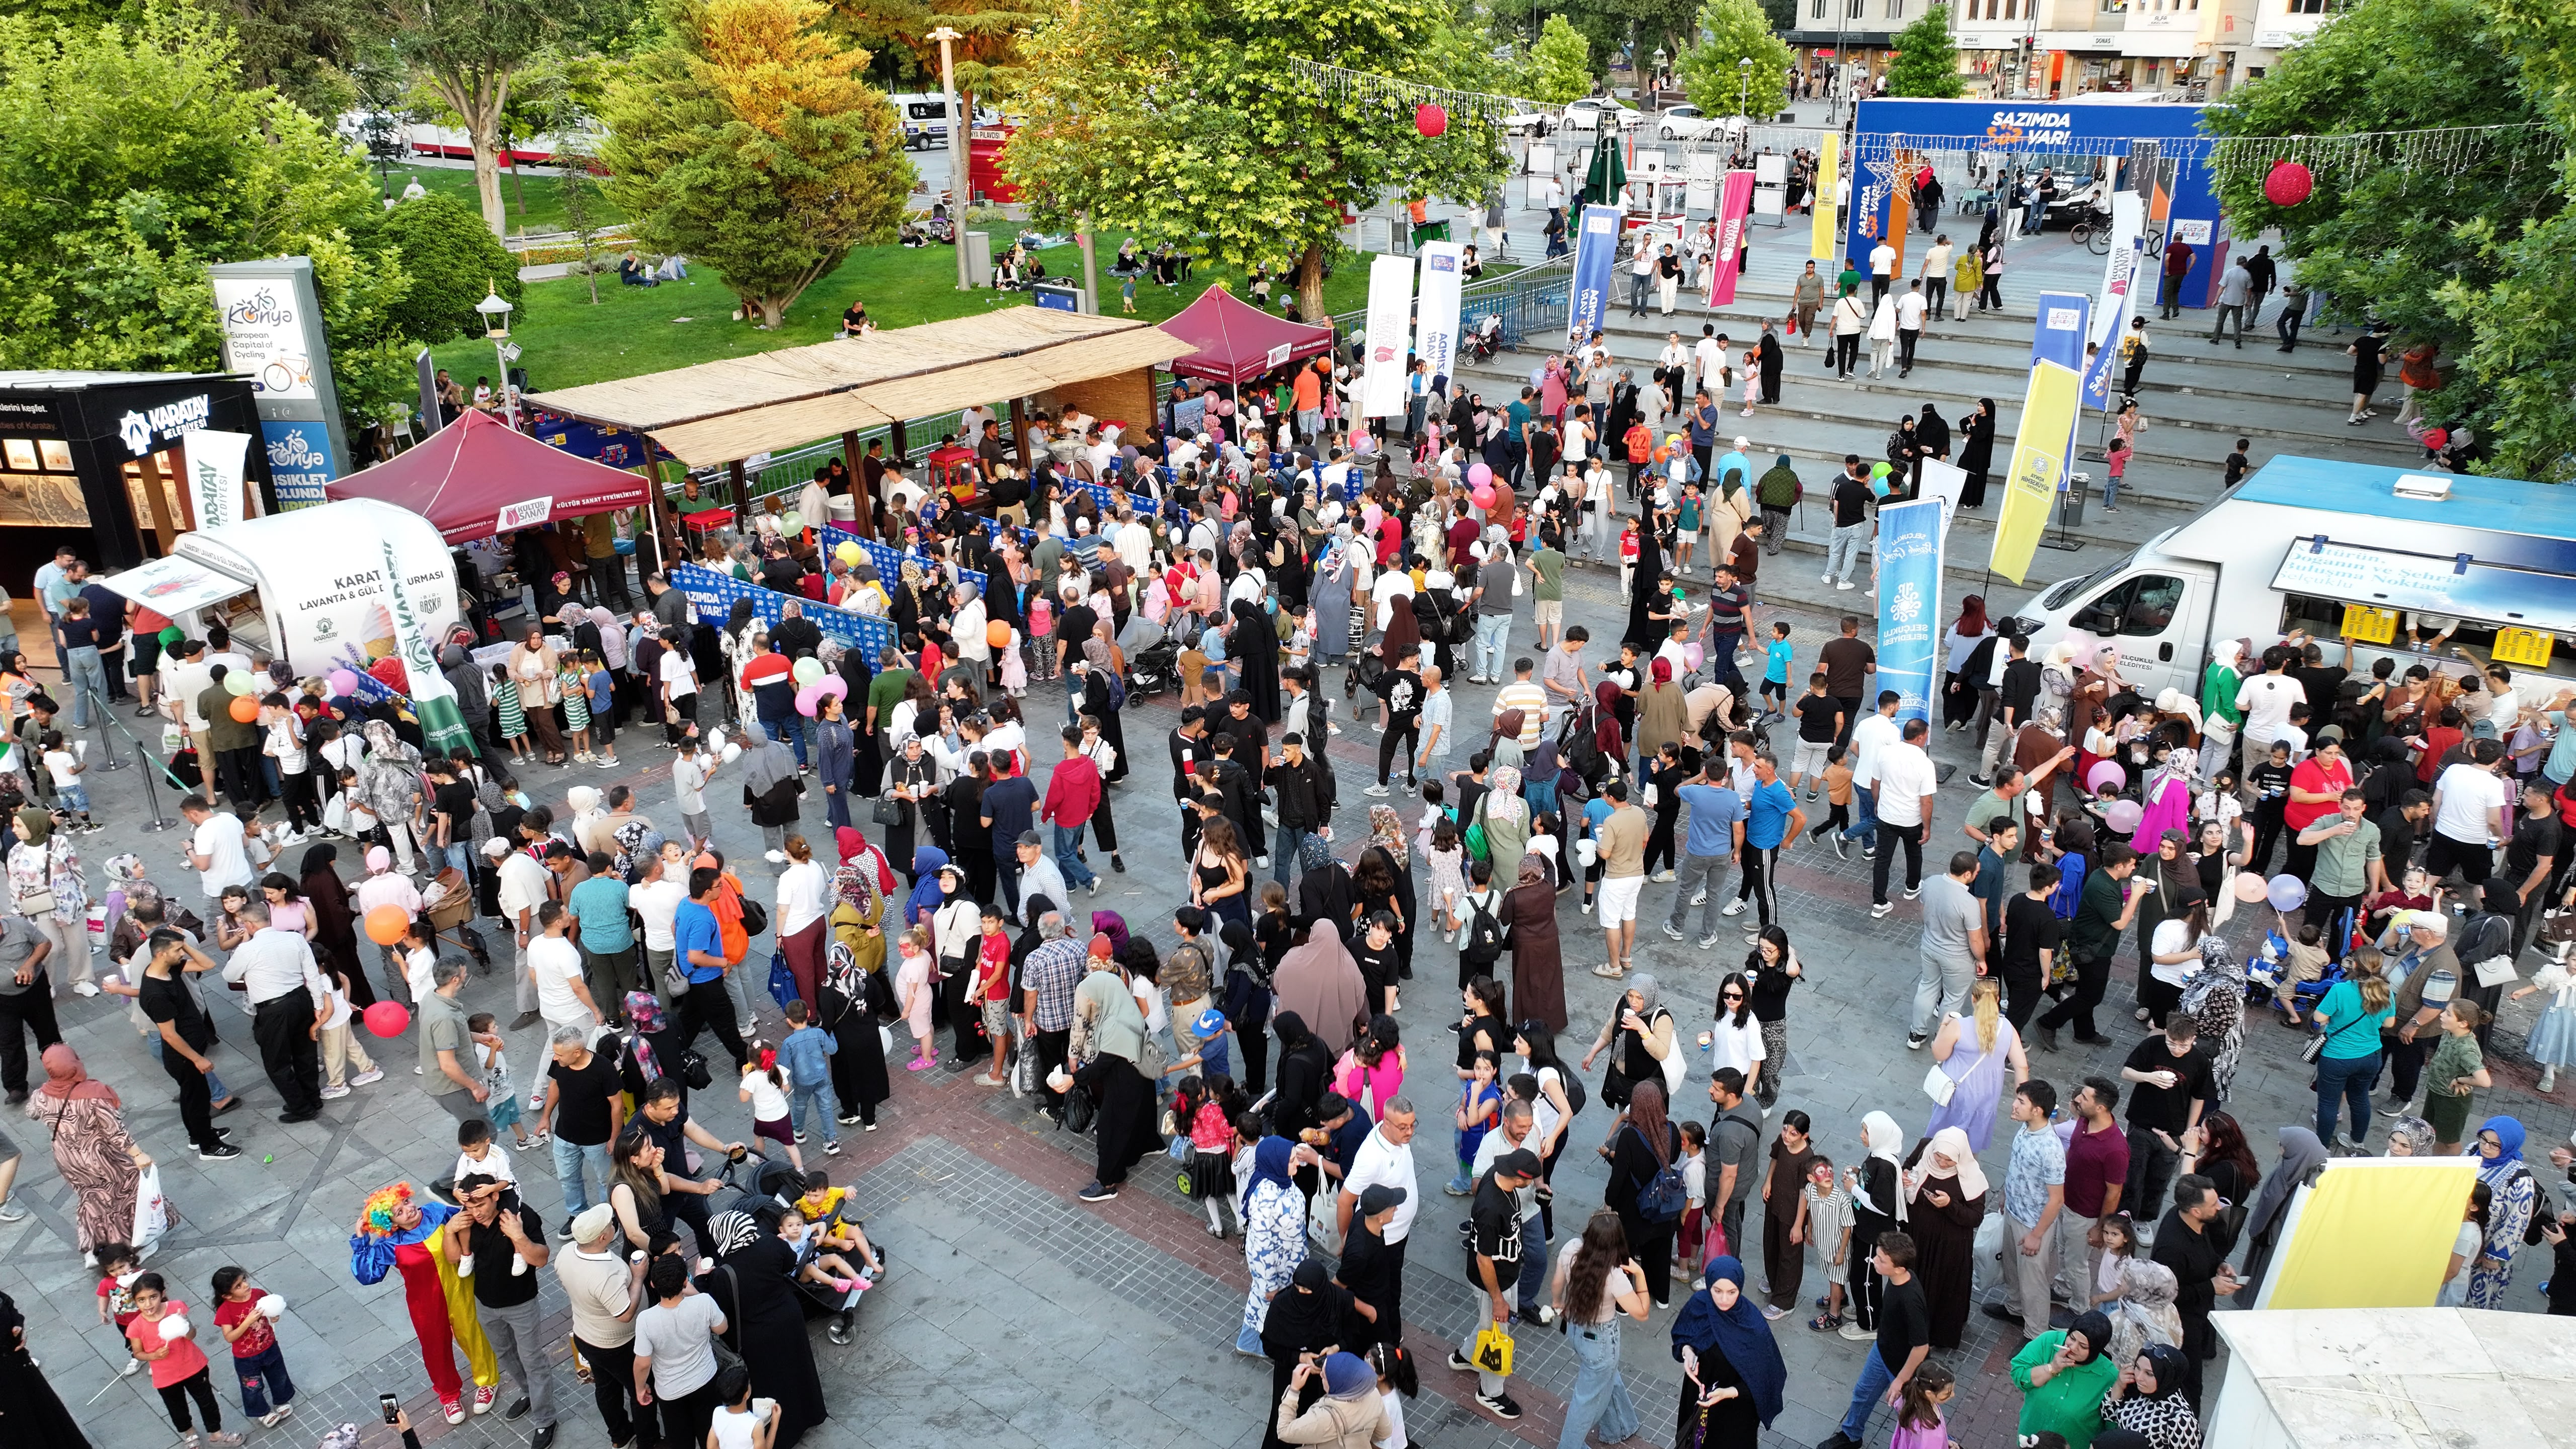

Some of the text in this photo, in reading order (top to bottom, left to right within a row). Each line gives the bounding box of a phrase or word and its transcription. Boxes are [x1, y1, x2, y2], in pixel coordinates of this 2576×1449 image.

[1991, 112, 2070, 128] SAZIMDA
[2029, 130, 2071, 145] VAR!
[1858, 185, 1871, 236] SAZIMDA
[2118, 249, 2130, 280] SANAT
[232, 341, 264, 349] Capital
[234, 351, 266, 359] Cycling
[1276, 351, 1289, 361] SANAT
[149, 393, 210, 432] KARATAY
[1632, 433, 1647, 449] 22
[272, 473, 328, 486] İSİKLET
[518, 500, 546, 513] KÜLTÜR
[556, 498, 581, 509] KÜLTÜR
[581, 496, 601, 505] SANAT
[519, 507, 547, 521] SANAT
[2373, 566, 2392, 575] ve
[334, 569, 381, 590] KARAT
[299, 594, 347, 611] LAVANTA
[349, 591, 356, 599] &
[357, 585, 377, 598] GÜL
[684, 590, 720, 605] AZIMDA
[701, 605, 722, 617] VAR!
[313, 631, 339, 642] KARATAY
[2121, 654, 2153, 664] ELÇUKLU
[2118, 661, 2153, 671] ELEDİYESİ
[428, 728, 447, 737] HASAN
